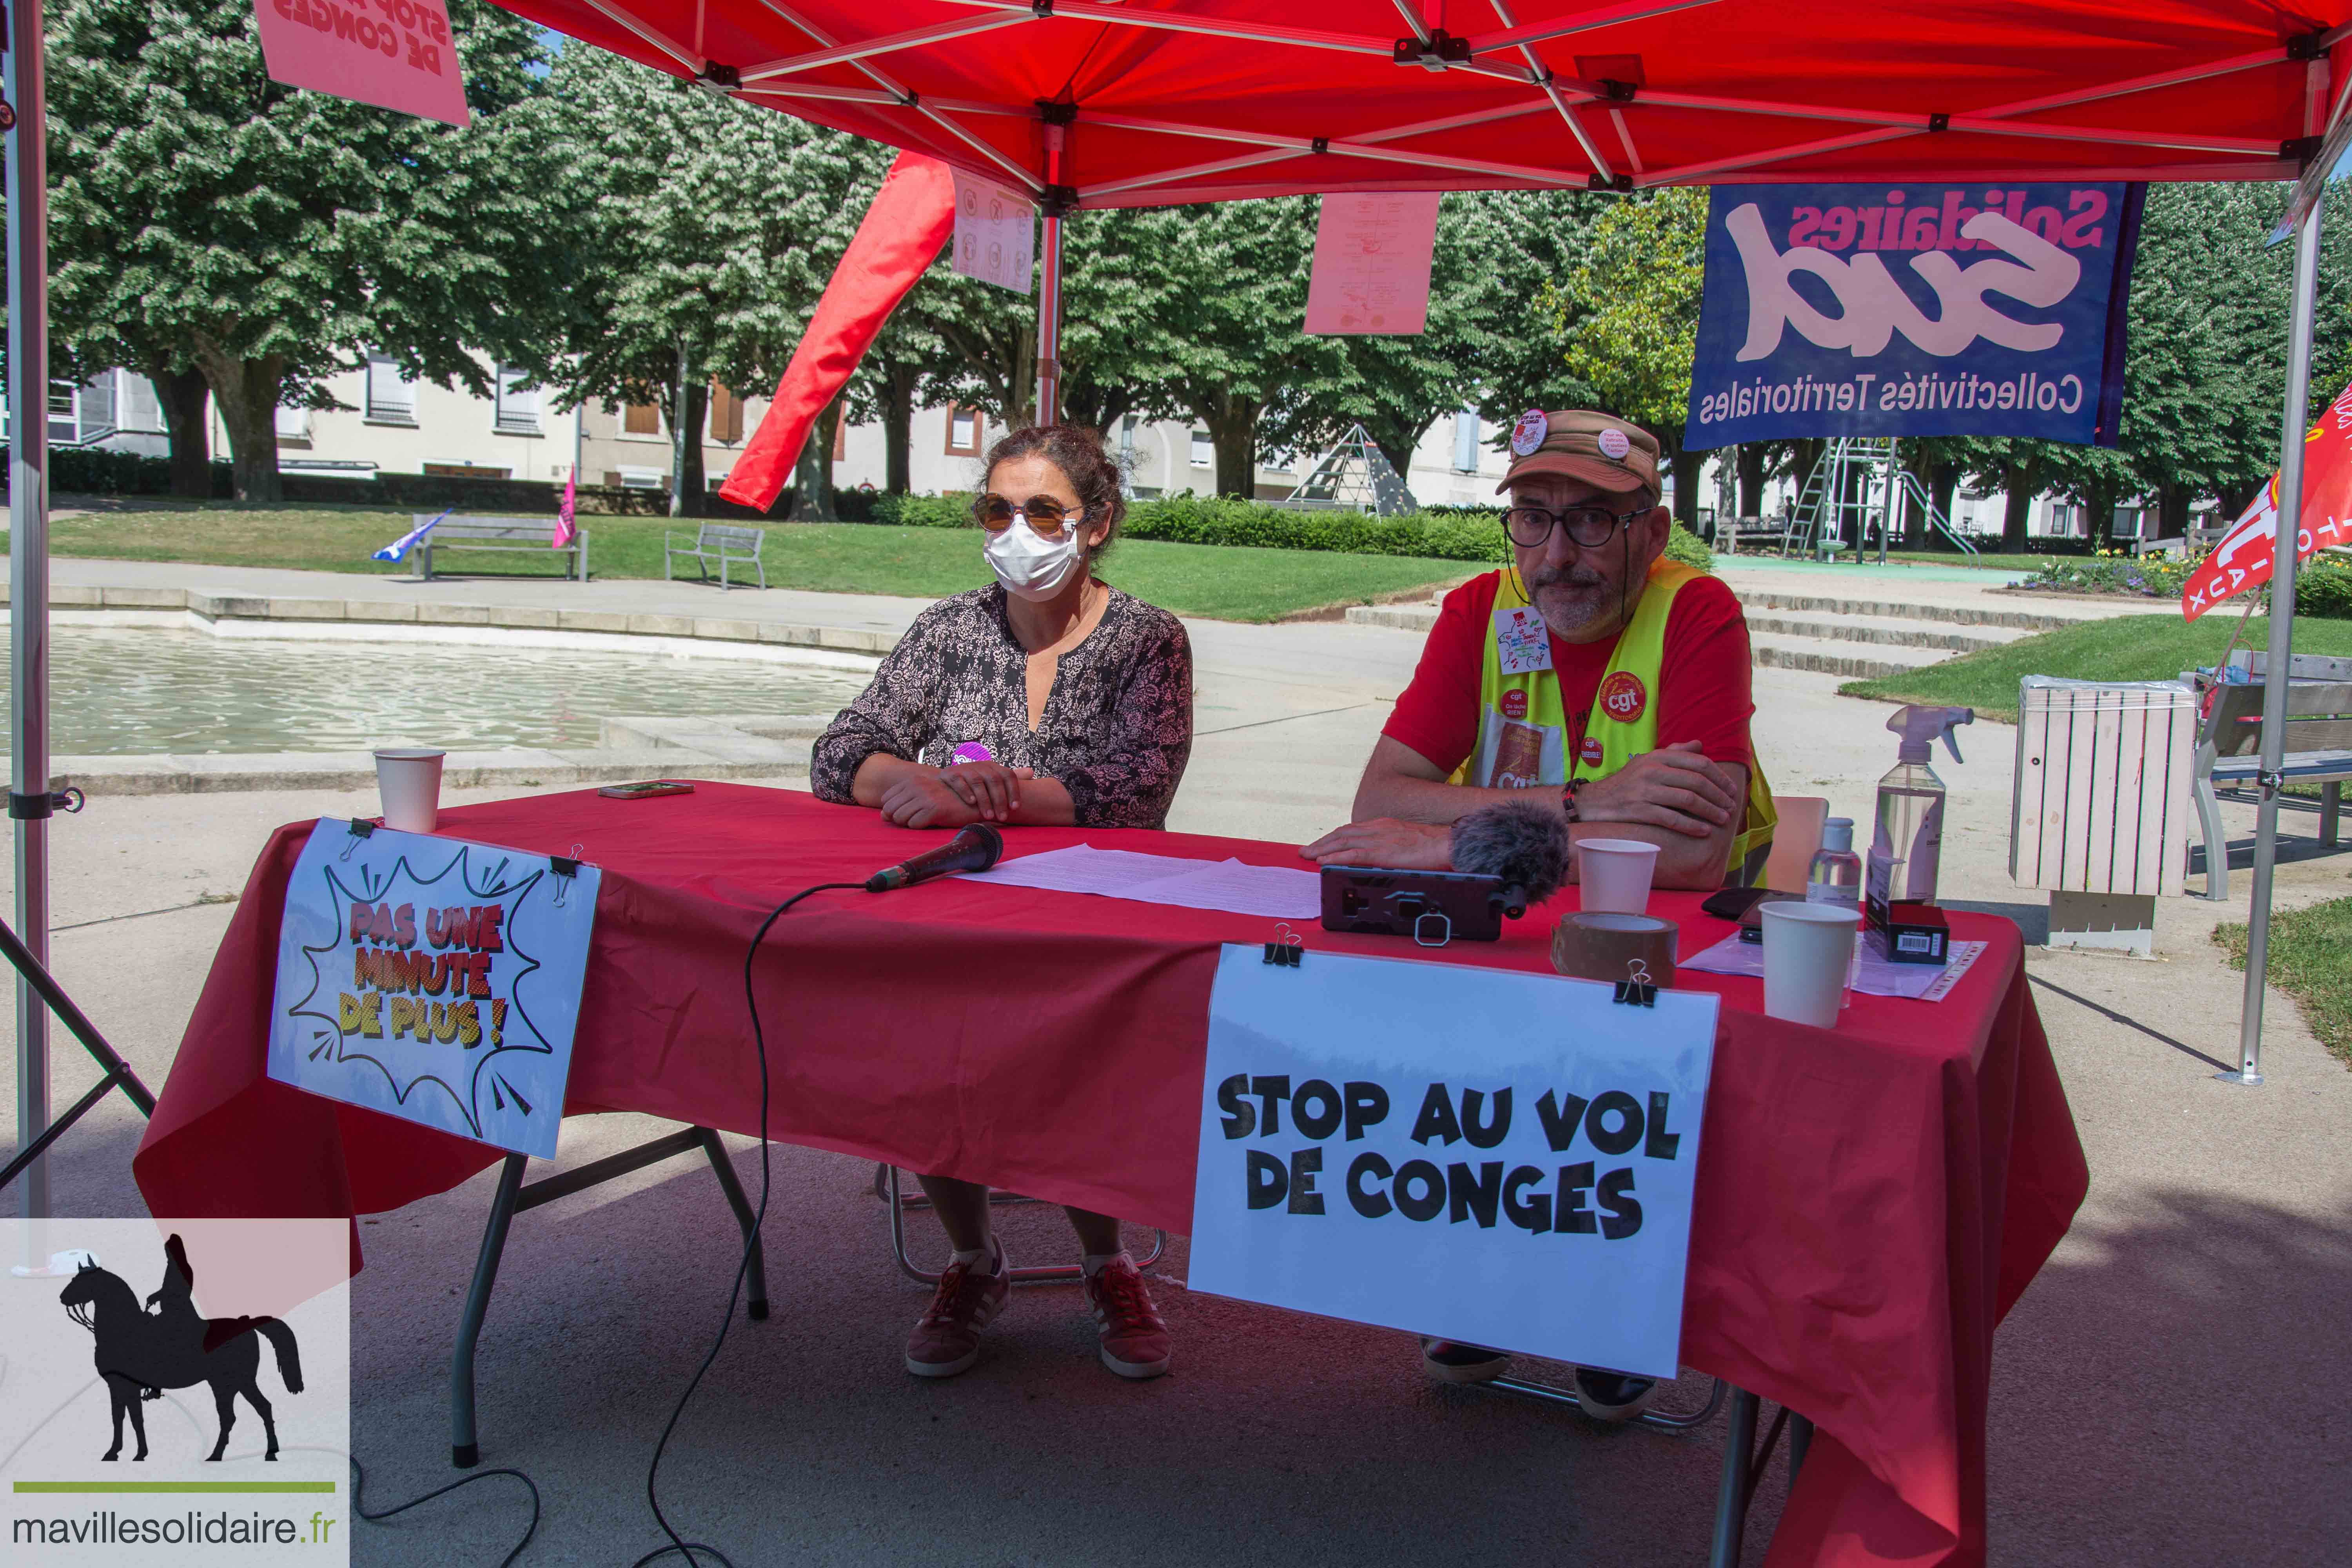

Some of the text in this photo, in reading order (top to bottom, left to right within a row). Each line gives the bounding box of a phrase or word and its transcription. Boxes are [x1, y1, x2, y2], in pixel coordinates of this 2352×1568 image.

[1608, 689, 1637, 712] cgt
[1608, 706, 1643, 720] TERRITORIAUX
[349, 902, 504, 953] PAS UNE
[354, 947, 492, 1000] MINUTE
[338, 992, 384, 1039] DE
[391, 997, 482, 1049] PLUS
[1217, 1073, 1681, 1160] STOP AU VOL
[1246, 1146, 1643, 1240] DE CONGES
